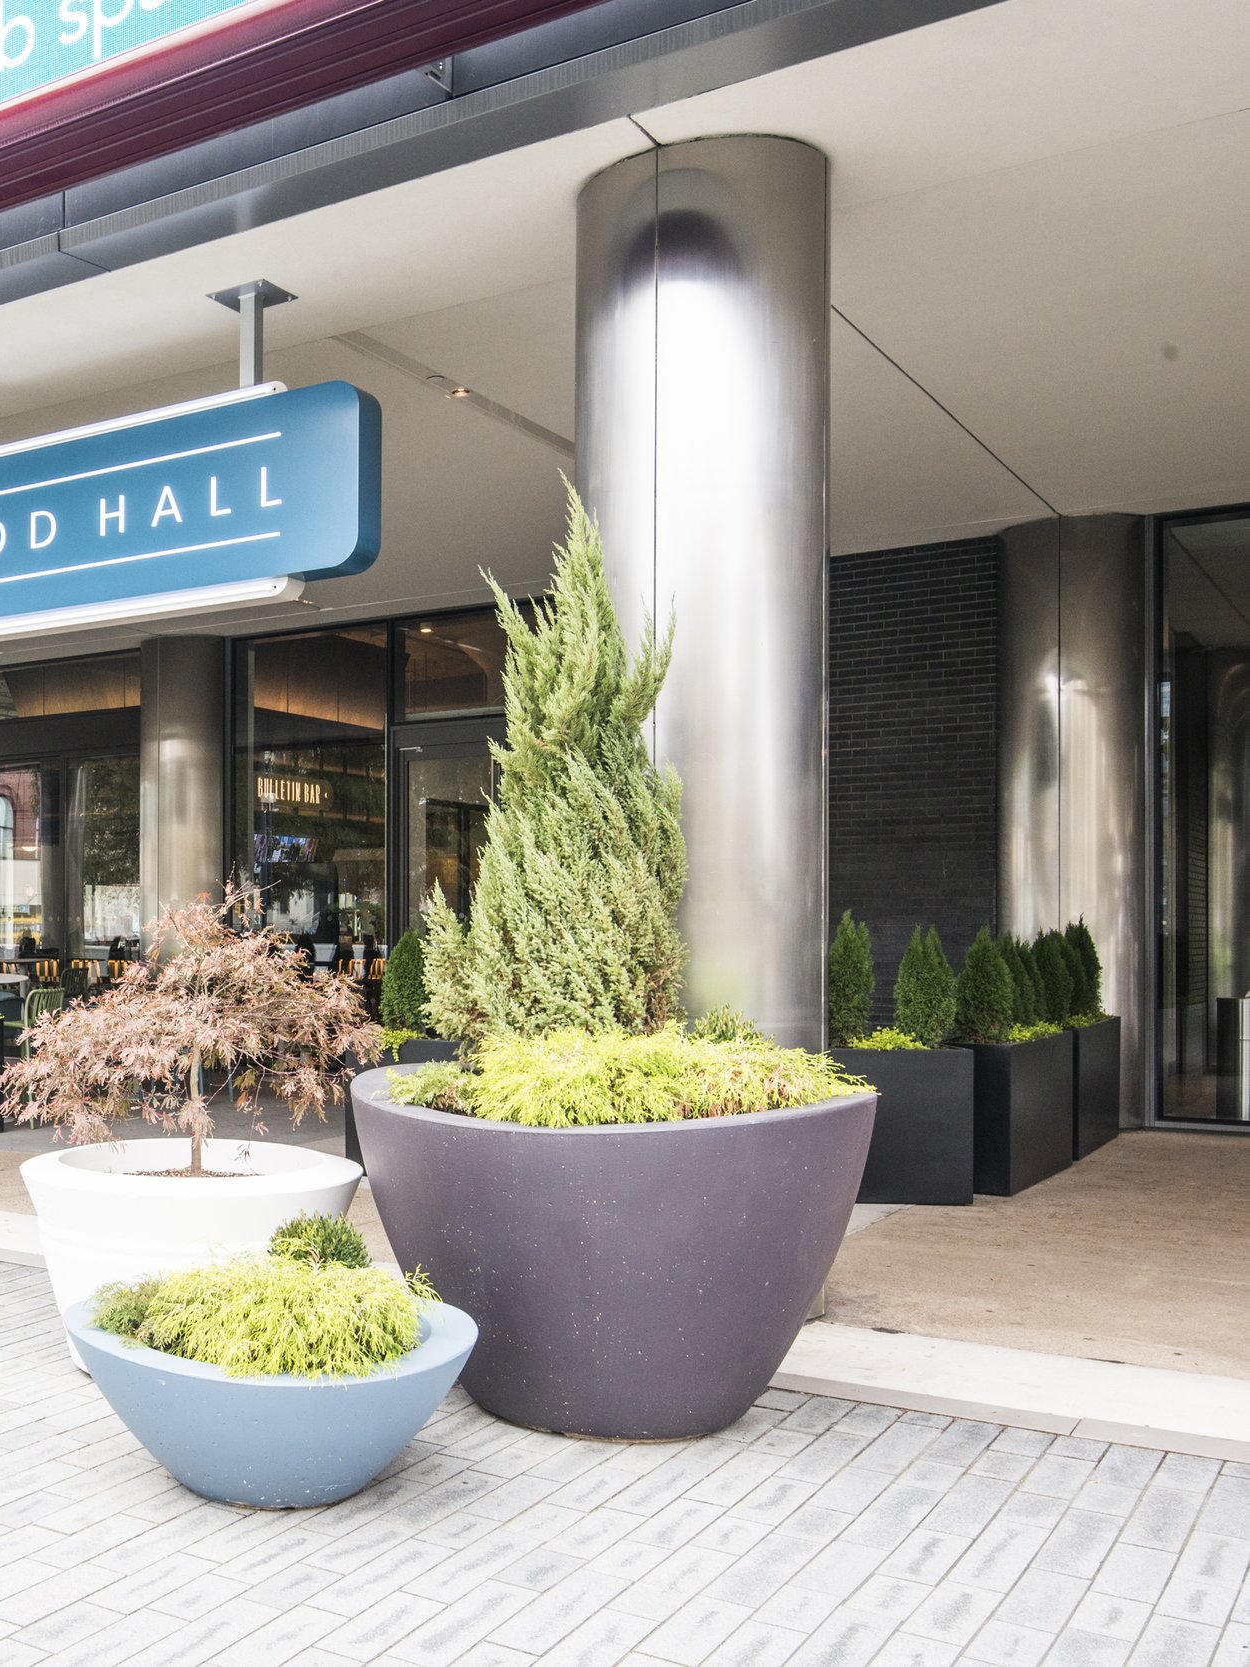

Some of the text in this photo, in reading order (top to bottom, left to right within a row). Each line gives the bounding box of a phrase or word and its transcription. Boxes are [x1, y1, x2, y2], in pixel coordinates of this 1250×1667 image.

[58, 0, 166, 60] sp
[99, 466, 283, 537] HALL
[257, 777, 321, 804] BULLETIN BAR
